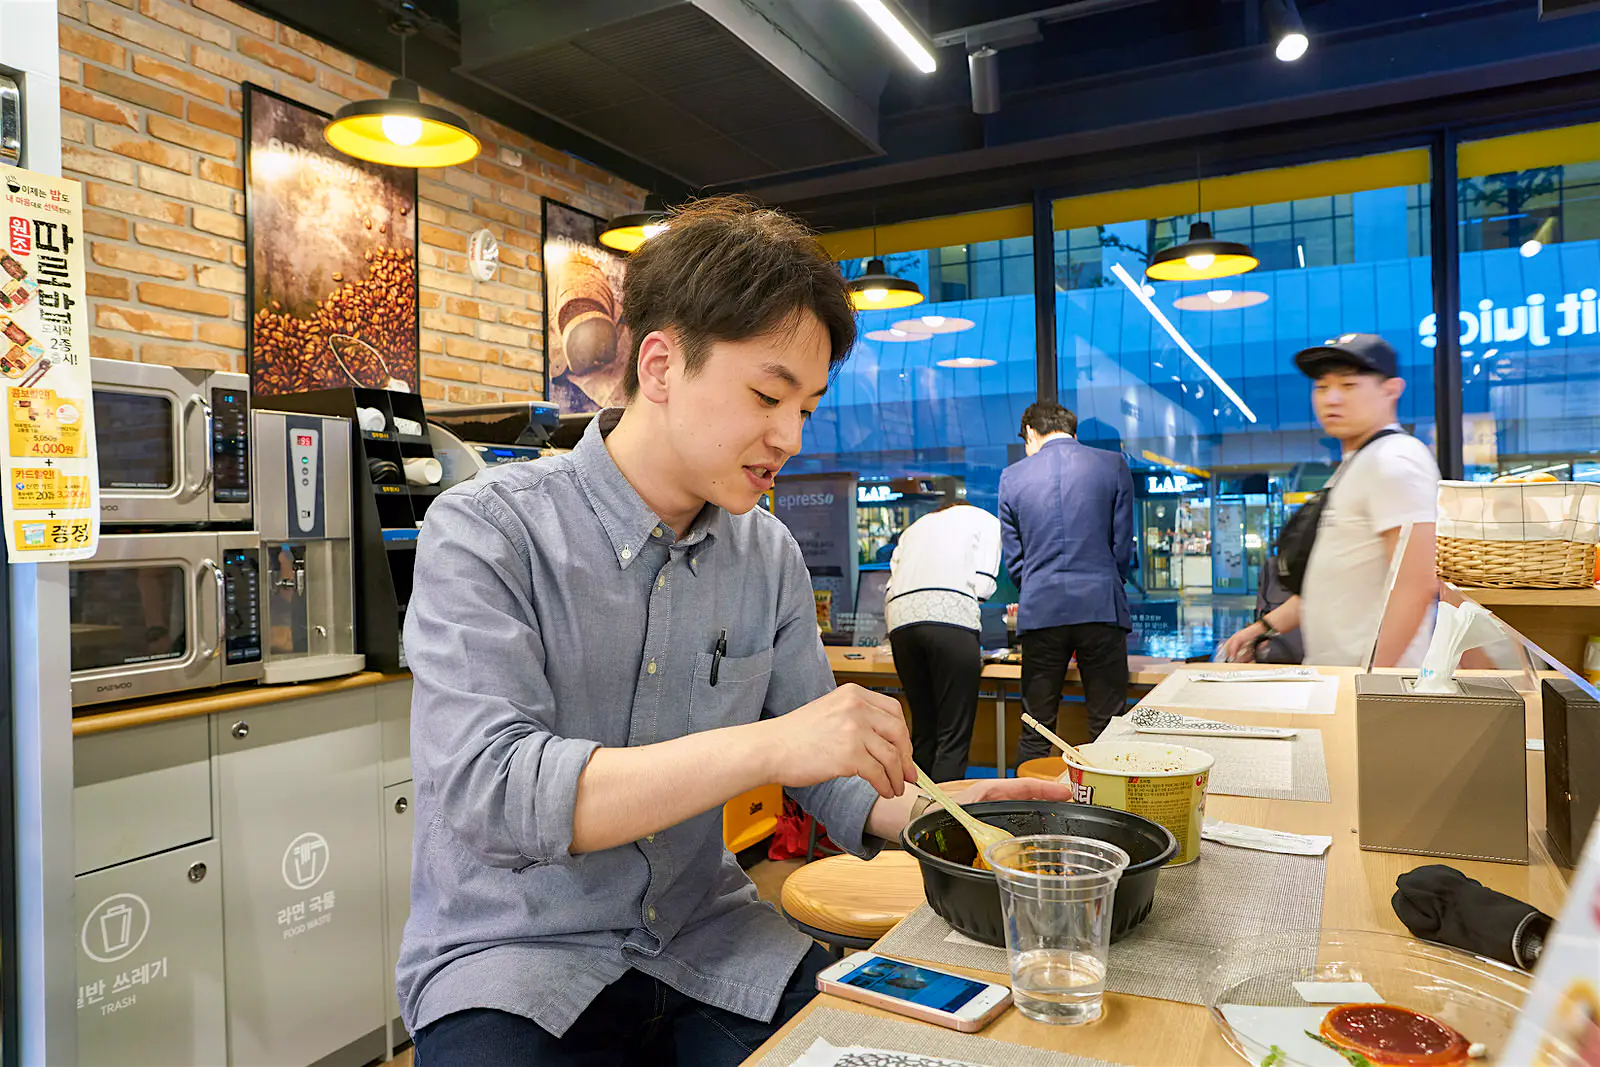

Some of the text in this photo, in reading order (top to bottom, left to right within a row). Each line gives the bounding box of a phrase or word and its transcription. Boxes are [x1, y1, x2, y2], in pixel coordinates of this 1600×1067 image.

[16, 196, 42, 209] 마음대로
[22, 185, 70, 203] 이제는 밥도
[11, 218, 31, 256] 원조
[50, 338, 72, 352] 2종
[32, 443, 74, 455] 4,000원
[778, 493, 834, 511] epresso
[51, 523, 89, 544] 증정
[97, 681, 133, 693] DAEWOO
[277, 901, 305, 926] 라면
[306, 912, 332, 930] WASTE
[111, 956, 168, 994] 쓰레기
[100, 994, 137, 1016] TRASH
